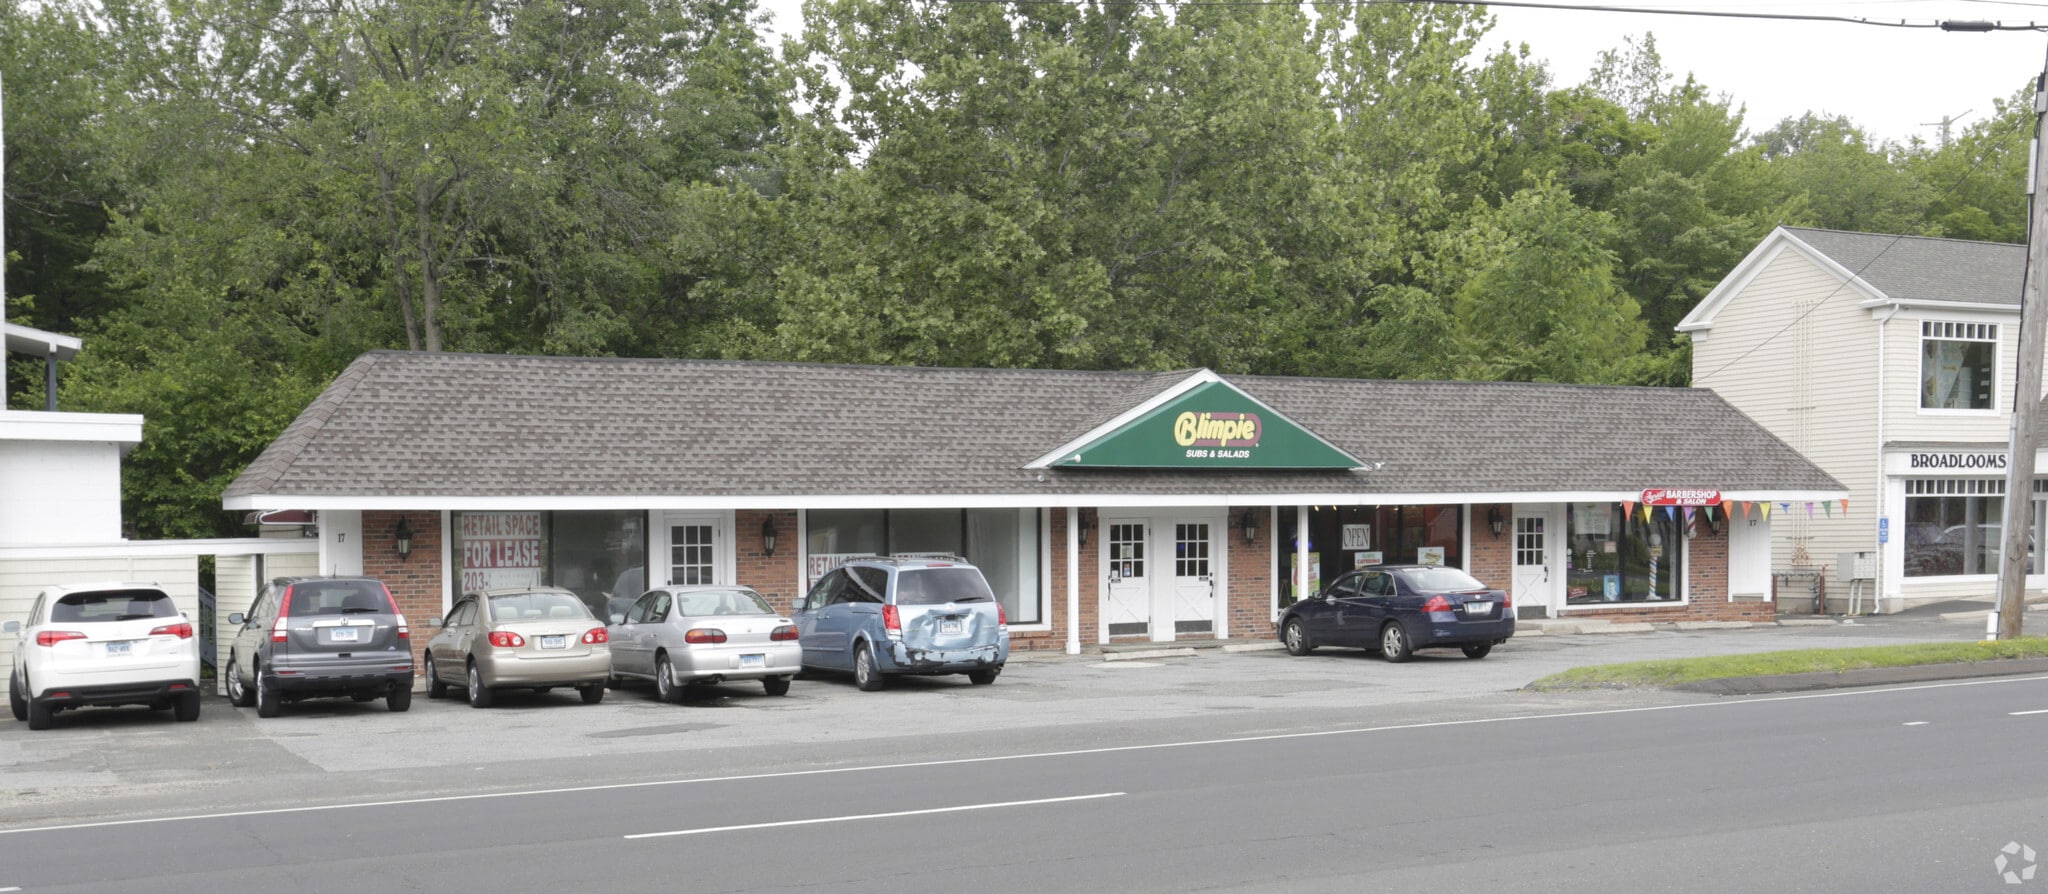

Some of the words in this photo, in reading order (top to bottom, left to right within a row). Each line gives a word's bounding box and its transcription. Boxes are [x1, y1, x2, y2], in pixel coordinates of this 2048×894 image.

[1174, 411, 1255, 447] Blimpie
[1186, 449, 1208, 458] SUBS
[1209, 450, 1215, 458] &
[1217, 450, 1250, 458] SALADS
[1911, 453, 2007, 468] BROADLOOMS
[1666, 490, 1717, 499] BARBERSHOP
[463, 515, 502, 536] RETAIL
[505, 514, 539, 535] SPACE
[338, 533, 345, 543] 17
[1343, 527, 1369, 547] OPEN
[464, 541, 492, 568] FOR
[496, 541, 539, 567] LEASE
